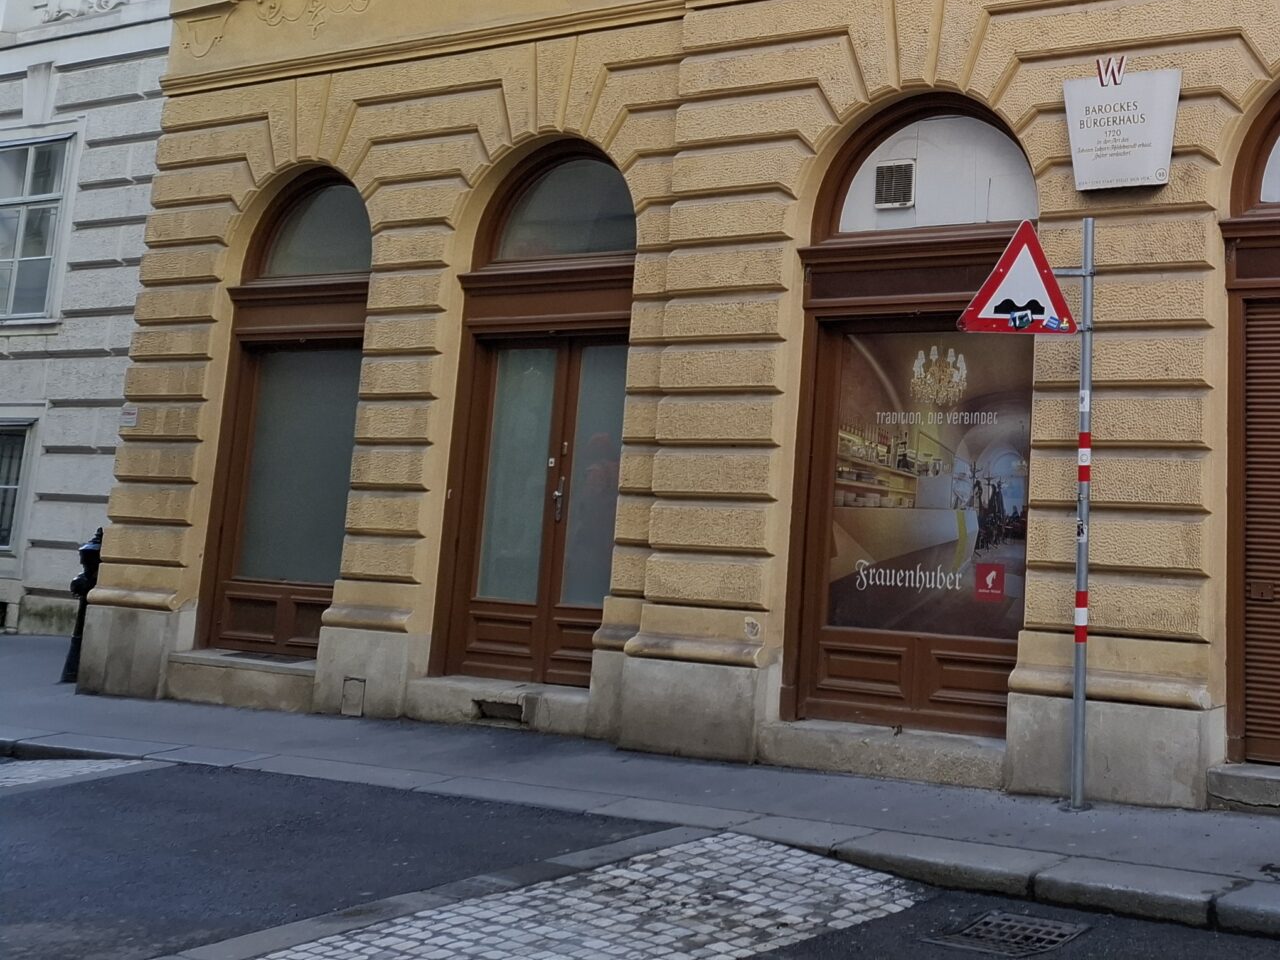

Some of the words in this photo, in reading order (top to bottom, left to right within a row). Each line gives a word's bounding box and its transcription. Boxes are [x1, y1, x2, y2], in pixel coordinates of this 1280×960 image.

[1096, 55, 1127, 87] W
[1084, 100, 1138, 116] BAROCKES
[1079, 113, 1146, 129] BÜRGERHAUS
[1104, 129, 1122, 138] 1720
[855, 559, 963, 594] Frauenhuber
